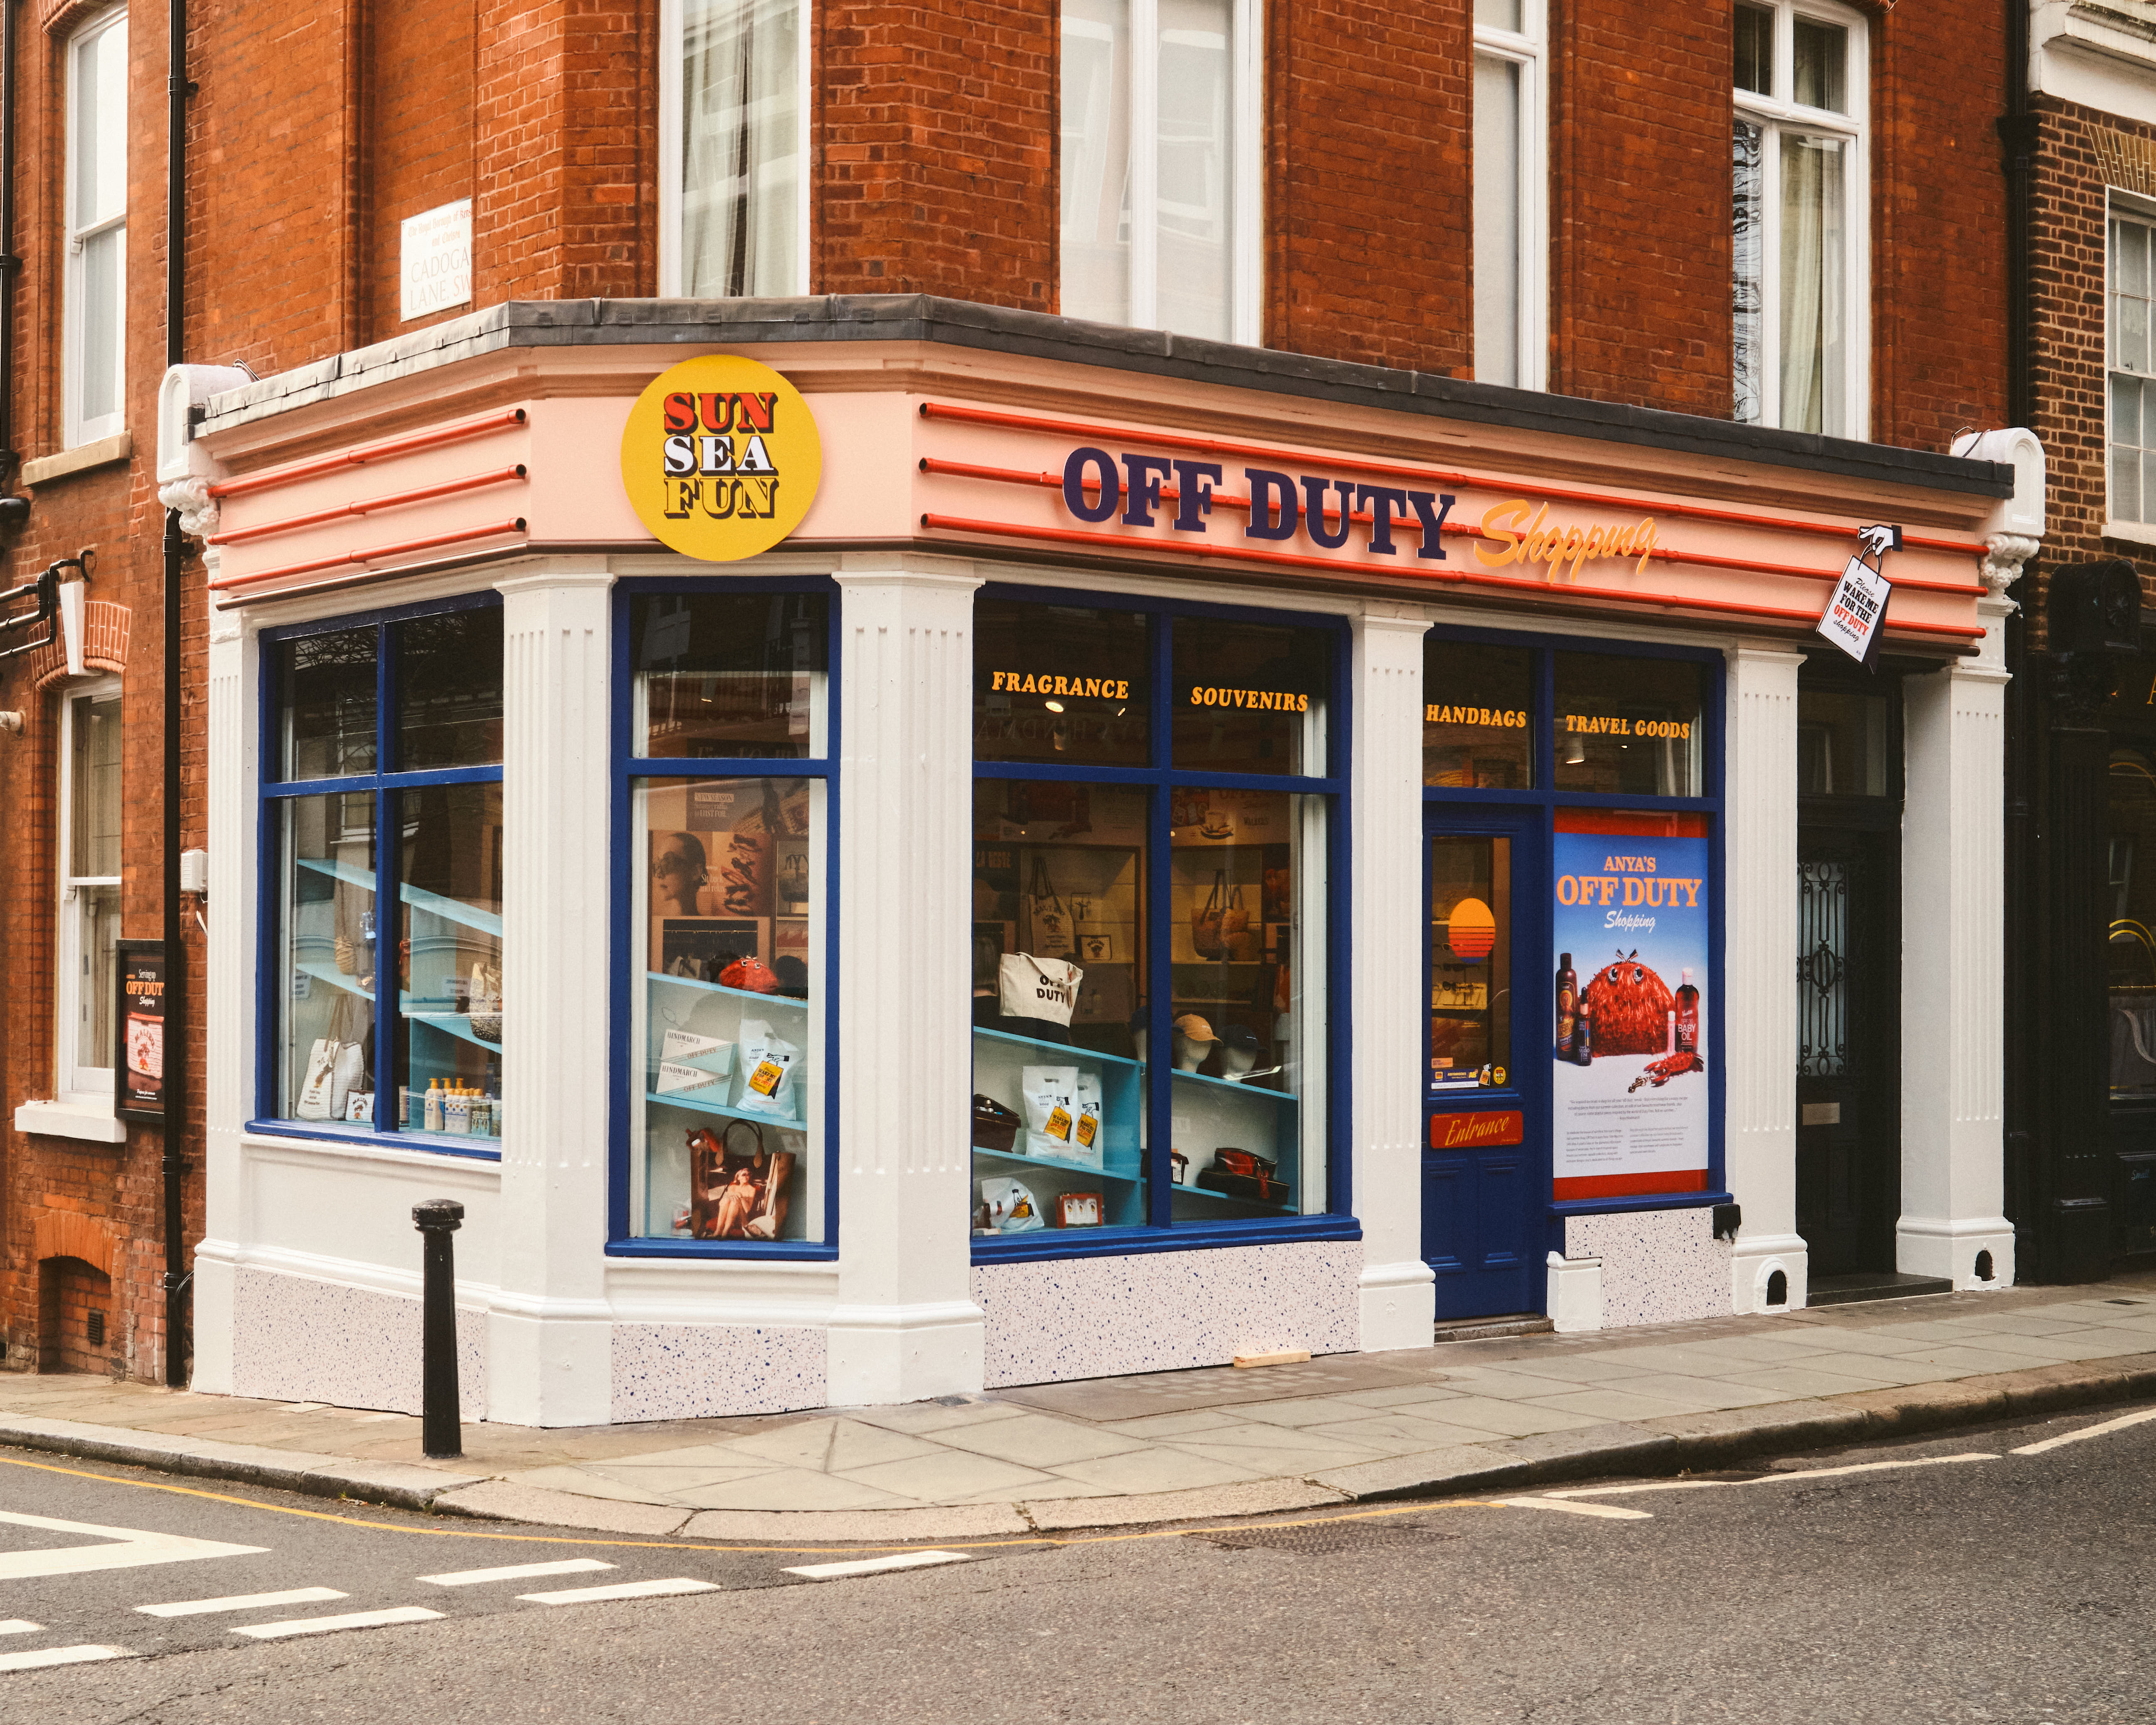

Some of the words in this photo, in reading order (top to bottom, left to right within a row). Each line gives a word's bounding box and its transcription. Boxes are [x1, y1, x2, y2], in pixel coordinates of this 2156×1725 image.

[408, 225, 417, 238] The
[418, 222, 431, 236] Royal
[433, 216, 451, 229] Borough
[453, 212, 459, 221] of
[431, 235, 440, 247] and
[442, 230, 460, 243] Chelsea
[664, 392, 778, 435] SUN
[664, 435, 778, 477] SEA
[664, 478, 779, 519] FUN
[1062, 446, 1222, 533] OFF
[1244, 467, 1455, 560] DUTY
[1474, 499, 1659, 585] Shopping
[1843, 580, 1866, 605] WAKE
[1866, 598, 1879, 615] ME
[1855, 577, 1875, 597] Please
[1834, 604, 1849, 621] OFF
[1849, 617, 1869, 636] DUTY
[1839, 594, 1856, 612] FOR
[1857, 606, 1872, 625] THE
[1833, 619, 1860, 643] shopping
[992, 671, 1128, 699] FRAGRANCE
[1191, 687, 1308, 712] SOUVENIRS
[1426, 704, 1526, 728] HANDBAGS
[1566, 715, 1630, 735] TRAVEL
[1635, 720, 1689, 739] GOODS
[1603, 856, 1656, 872] ANYA'S
[1557, 875, 1618, 906] OFF
[1622, 877, 1702, 907] DUTY
[1604, 909, 1655, 934] Shopping
[126, 981, 144, 995] OFF
[144, 981, 165, 996] DUT
[1036, 988, 1065, 1003] DUTY
[667, 1031, 701, 1044] HINDMARCH
[1678, 1024, 1696, 1032] BABY
[1681, 1032, 1692, 1041] OIL
[700, 1047, 716, 1056] DUTY
[662, 1065, 698, 1078] HINDMARCH
[697, 1079, 715, 1089] DUTY
[1445, 1114, 1509, 1146] Entrance
